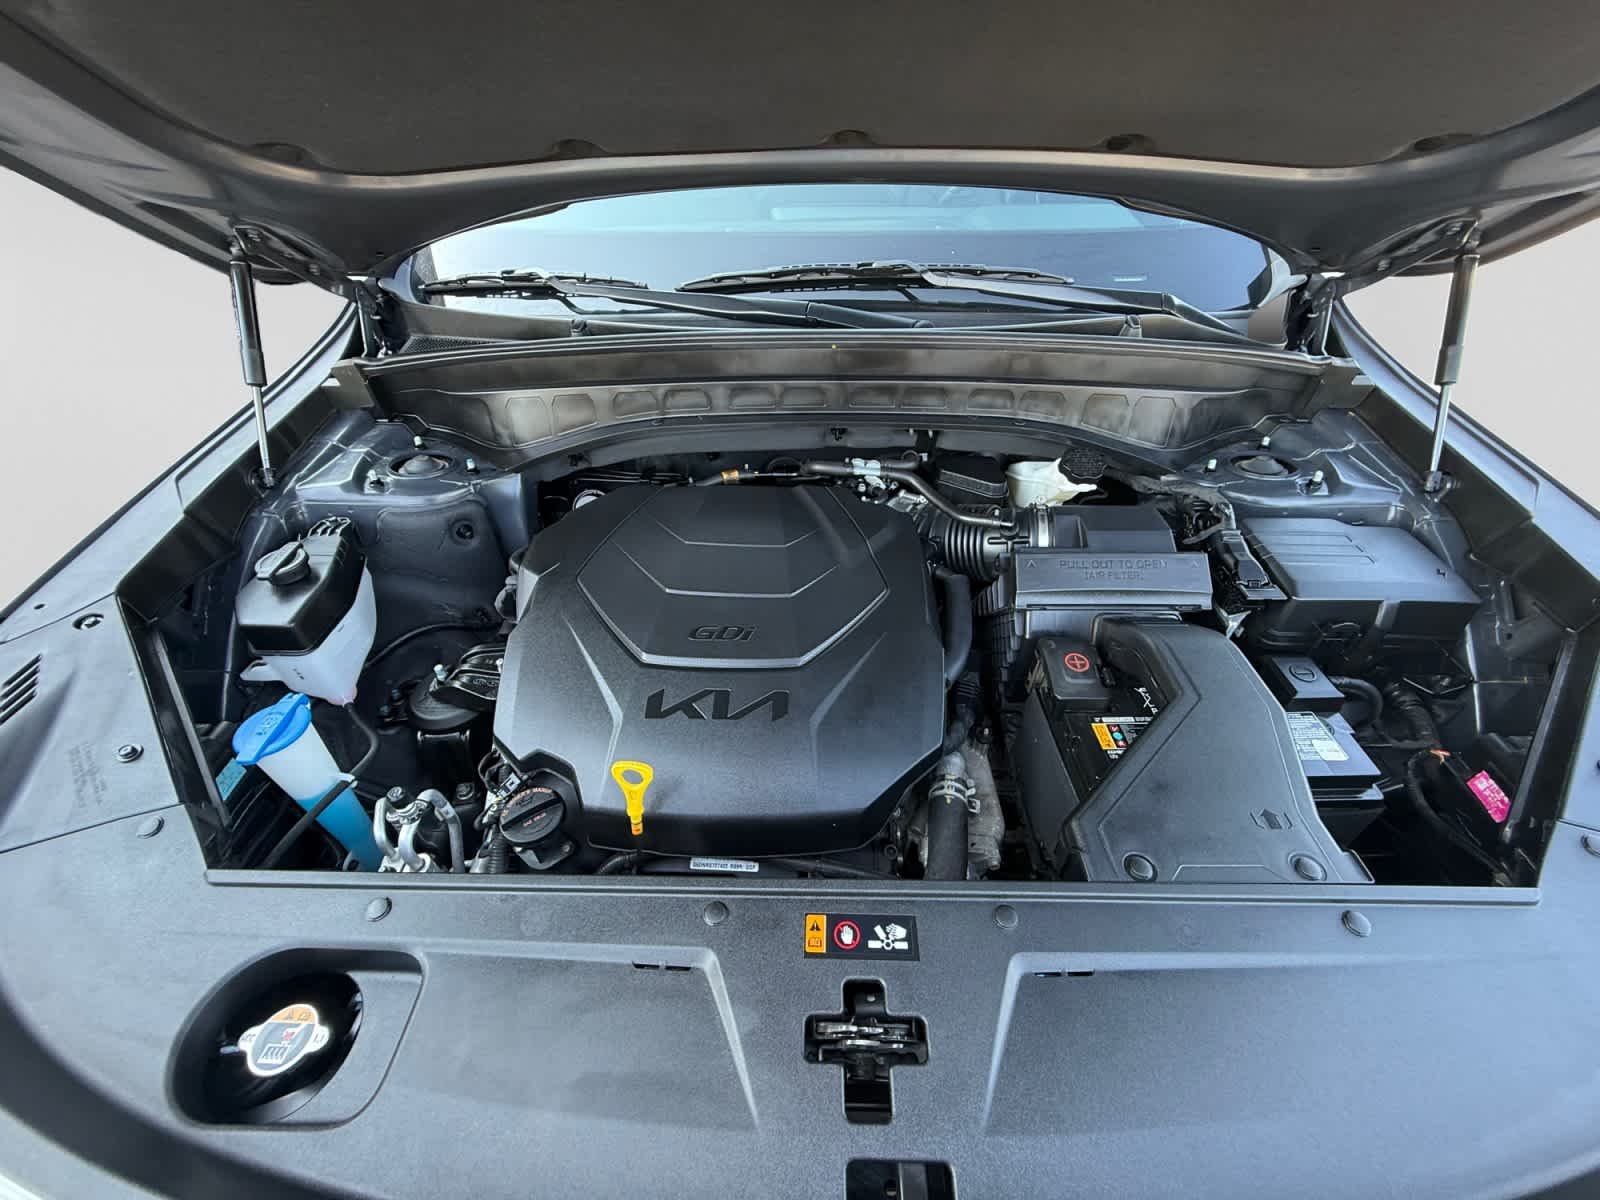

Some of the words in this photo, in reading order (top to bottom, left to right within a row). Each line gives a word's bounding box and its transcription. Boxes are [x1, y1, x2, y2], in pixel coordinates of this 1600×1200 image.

[1058, 559, 1088, 569] PULL
[1091, 559, 1114, 569] OUT
[1119, 559, 1134, 569] TO
[1136, 559, 1168, 569] OPEN
[688, 625, 758, 641] GDi
[645, 688, 790, 721] KIA
